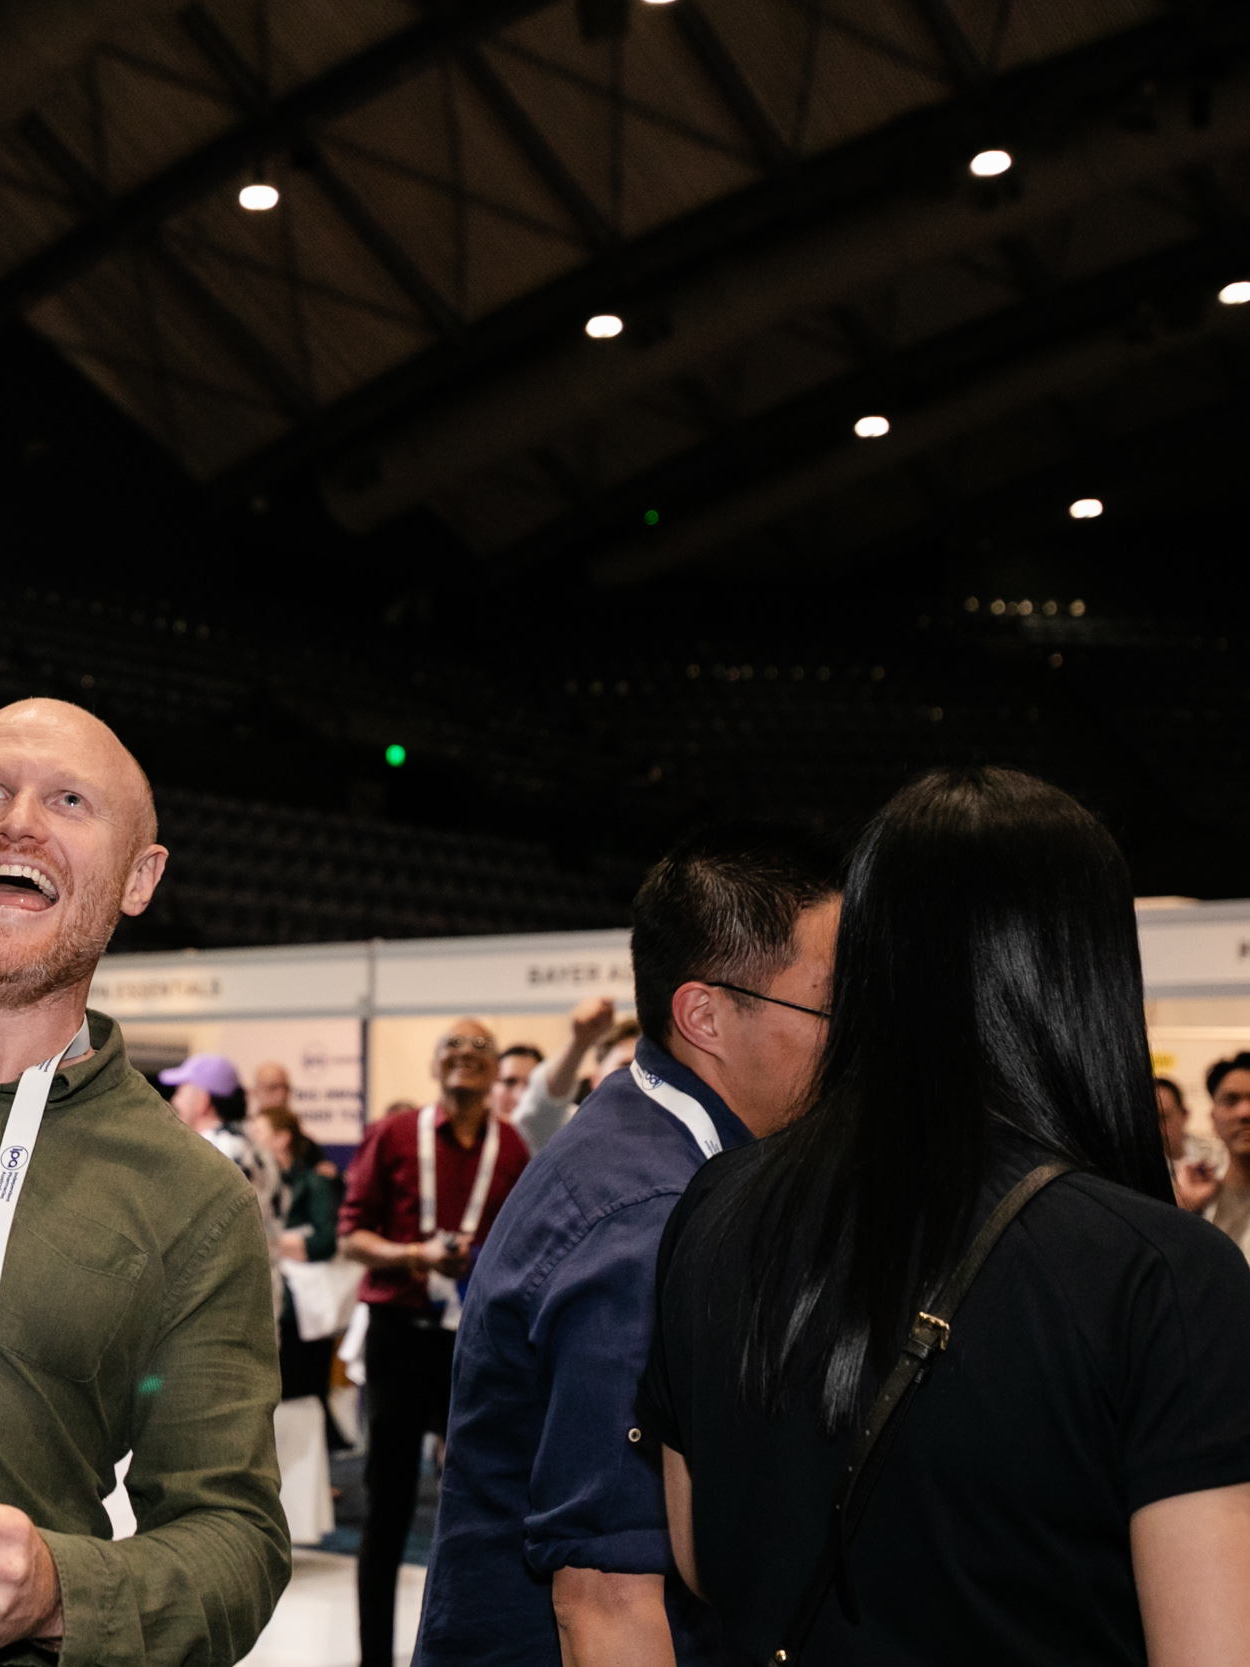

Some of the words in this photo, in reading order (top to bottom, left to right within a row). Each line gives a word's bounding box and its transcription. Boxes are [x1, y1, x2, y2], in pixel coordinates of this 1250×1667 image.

[527, 963, 599, 987] BAYER
[7, 1147, 24, 1168] ipa
[0, 1171, 13, 1200] Pharmacies
[5, 1171, 19, 1203] Independent
